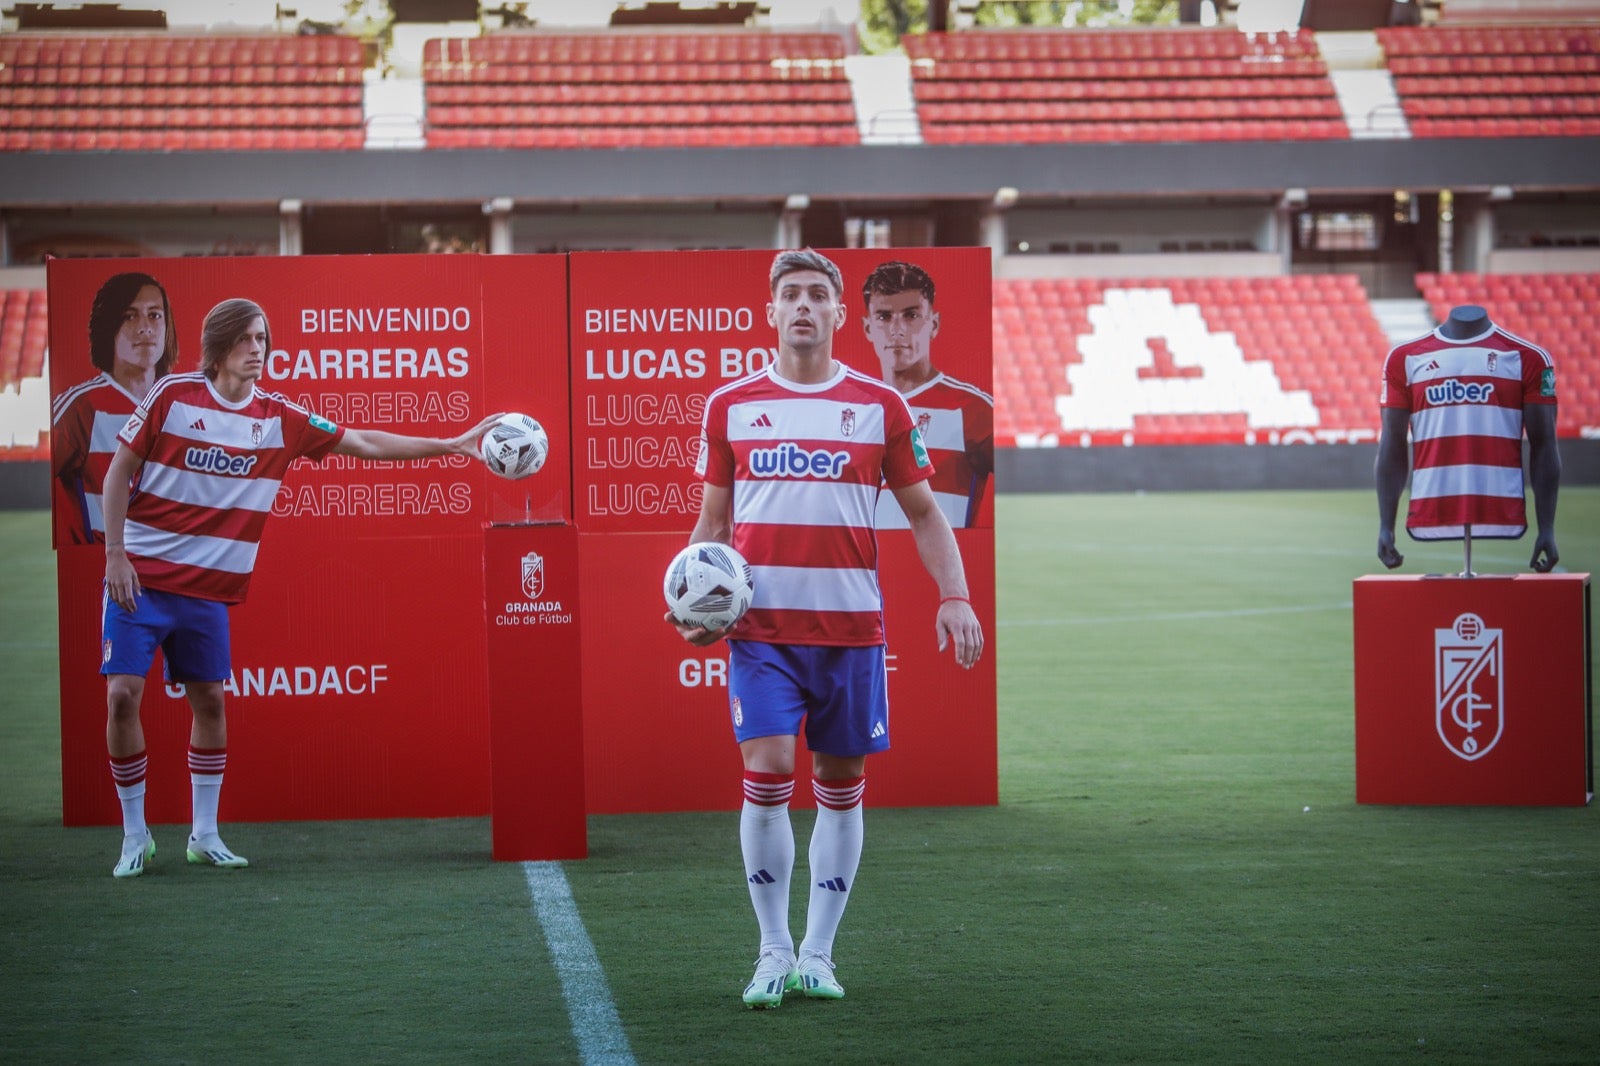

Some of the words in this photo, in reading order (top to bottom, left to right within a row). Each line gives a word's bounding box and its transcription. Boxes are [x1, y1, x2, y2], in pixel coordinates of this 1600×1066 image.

[301, 307, 471, 333] BIENVENIDO
[585, 307, 753, 333] BIENVENIDO
[267, 347, 469, 380] CARRERAS
[586, 348, 706, 380] LUCAS
[720, 347, 780, 378] BO
[282, 391, 470, 424] ARRERAS
[1426, 379, 1494, 404] wiber
[587, 393, 706, 426] LUCAS
[185, 448, 257, 475] wiber
[588, 436, 701, 469] LUCAS
[751, 443, 850, 478] wiber
[270, 482, 471, 517] CARRERAS
[589, 482, 705, 515] LUCAS
[495, 614, 520, 626] Club
[522, 614, 536, 625] de
[538, 613, 572, 625] Fútbol
[505, 601, 562, 613] GRANADA
[165, 664, 388, 699] GANADACF
